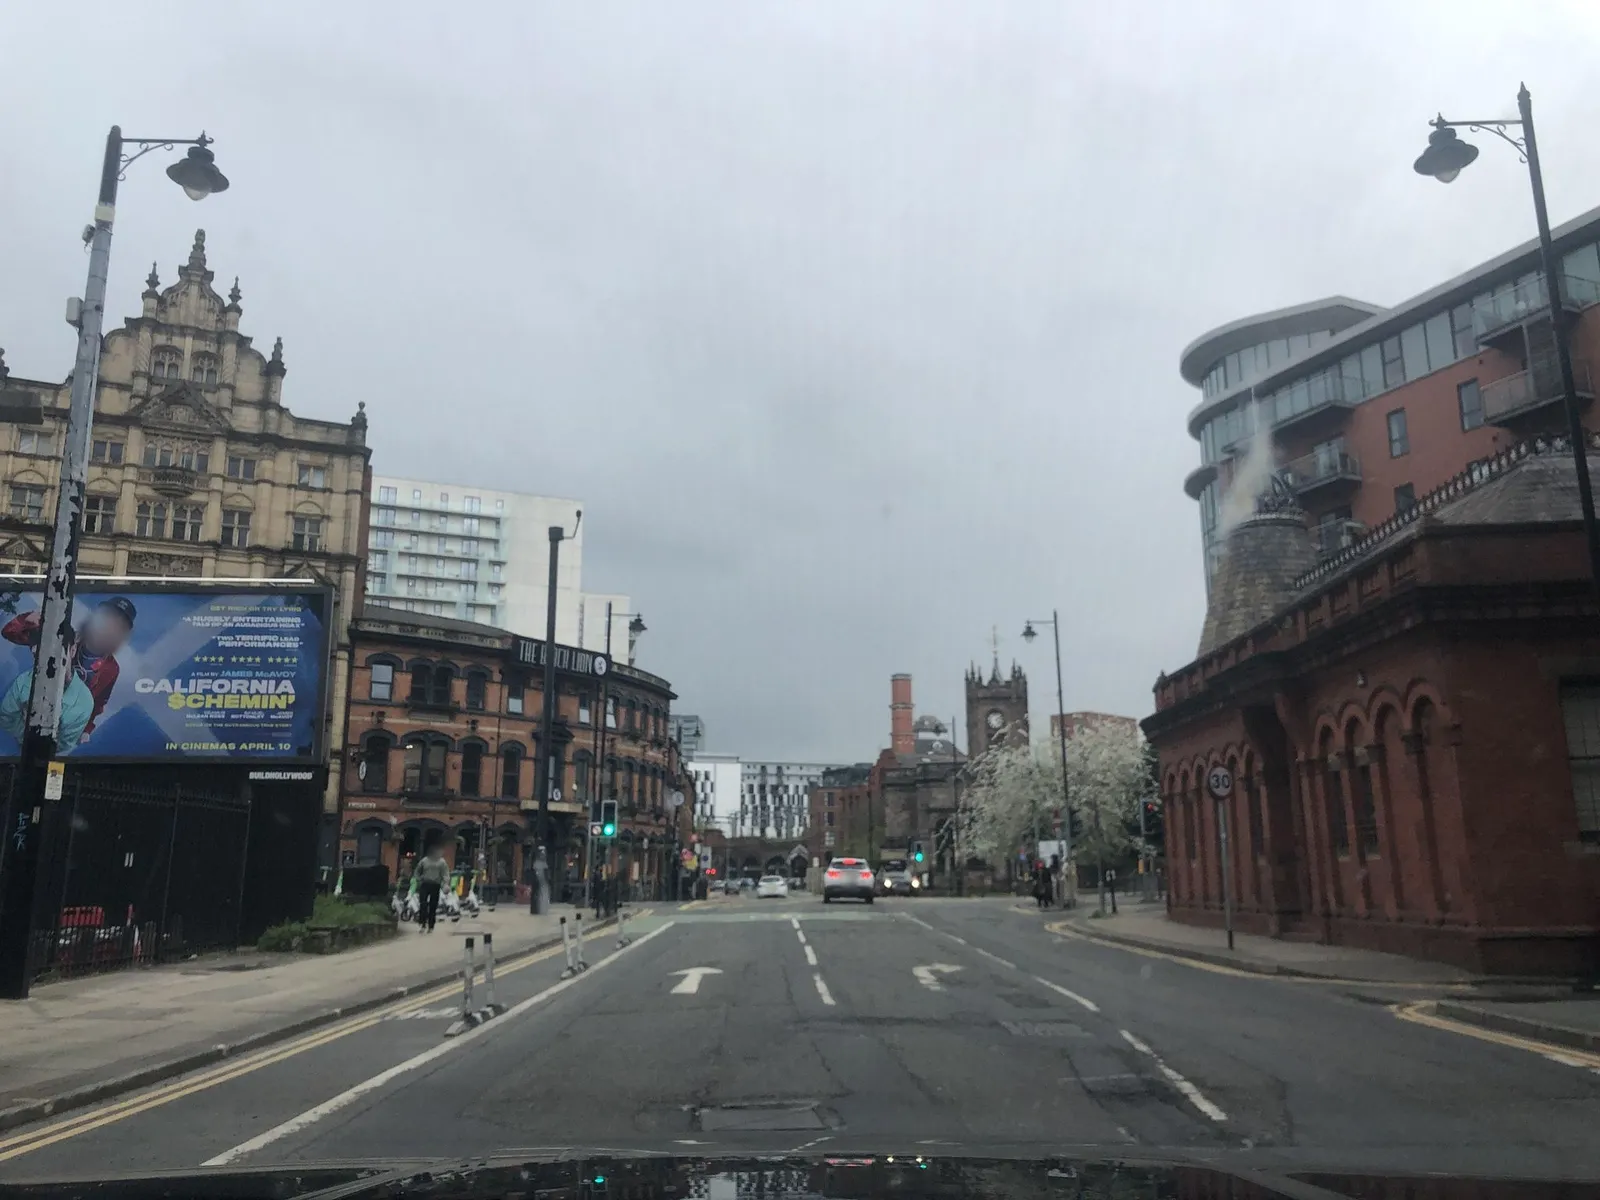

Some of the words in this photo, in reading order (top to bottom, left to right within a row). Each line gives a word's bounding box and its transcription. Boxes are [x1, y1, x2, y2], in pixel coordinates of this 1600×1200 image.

[519, 639, 538, 663] THE
[571, 650, 594, 675] LION
[134, 677, 295, 694] CALIFORNIA
[165, 742, 178, 750] IN
[181, 742, 236, 750] CINEMAS
[239, 742, 275, 750] APRIL
[278, 742, 291, 750] 10
[1212, 774, 1230, 789] 30
